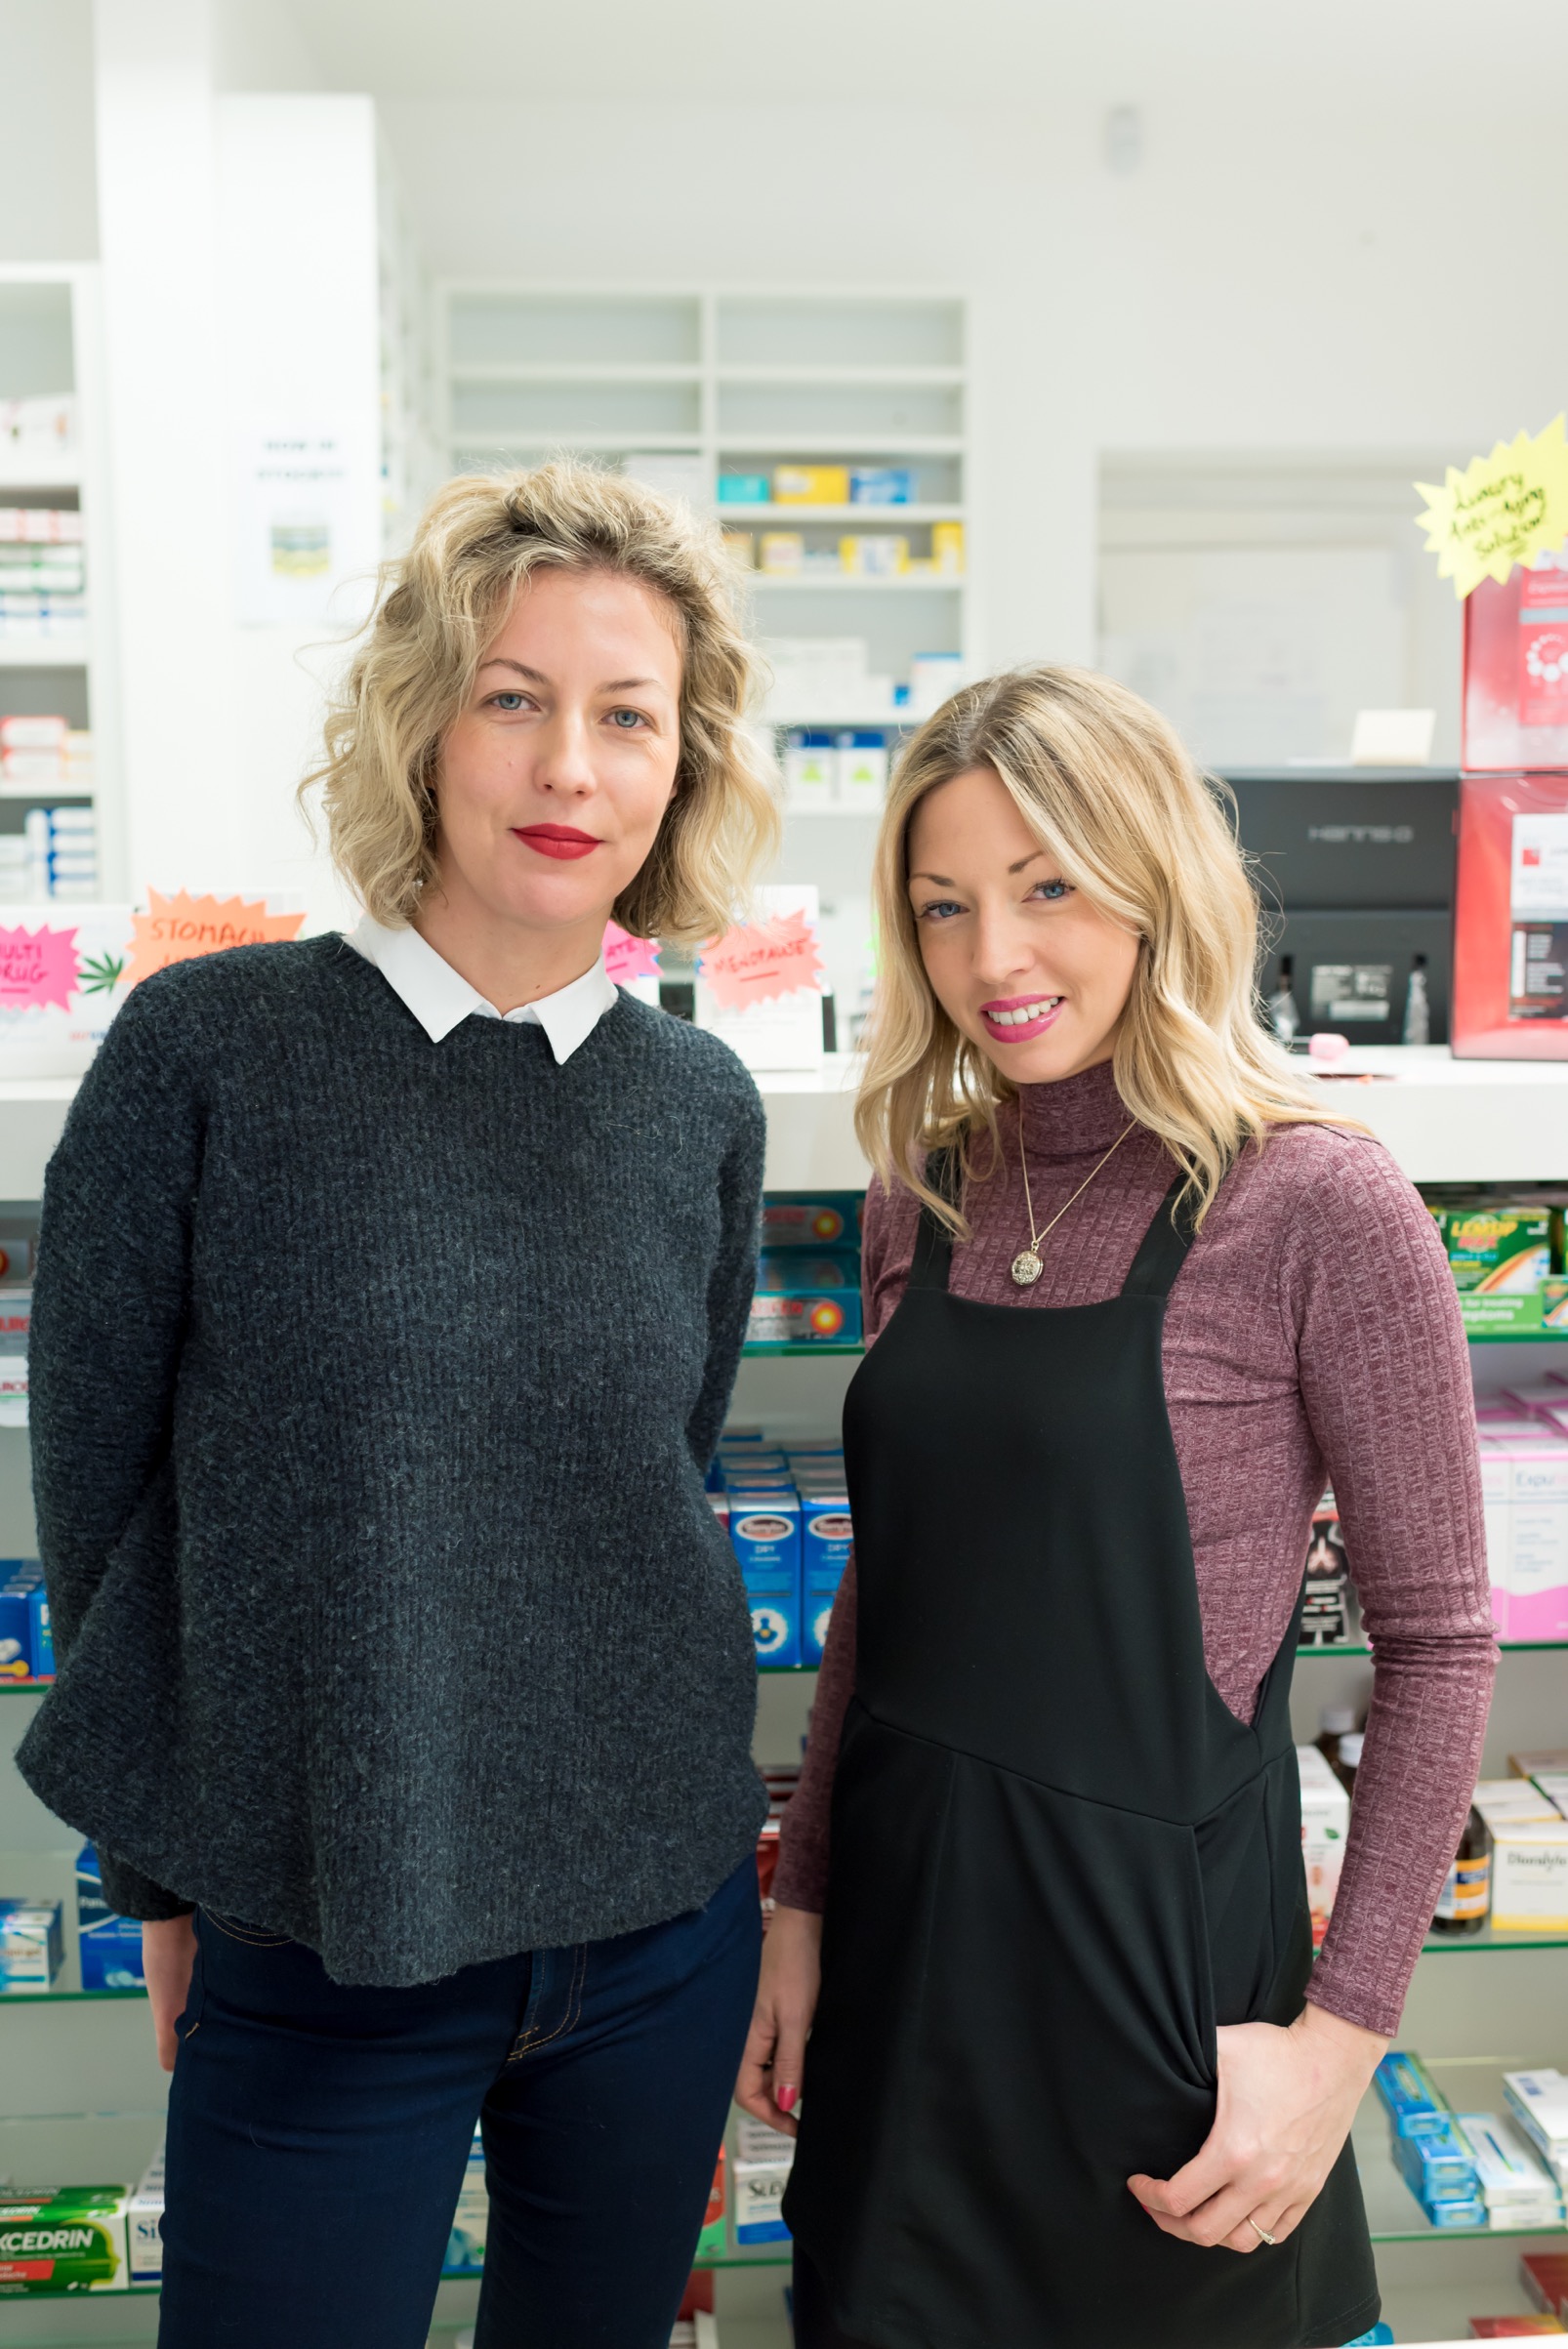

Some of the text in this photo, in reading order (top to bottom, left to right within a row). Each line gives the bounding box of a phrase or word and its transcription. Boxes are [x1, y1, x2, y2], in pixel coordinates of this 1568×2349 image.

[150, 918, 267, 945] STOMACH
[0, 943, 43, 961] ULTI
[0, 963, 49, 984] RUG
[0, 2228, 95, 2252] XCEDRIN
